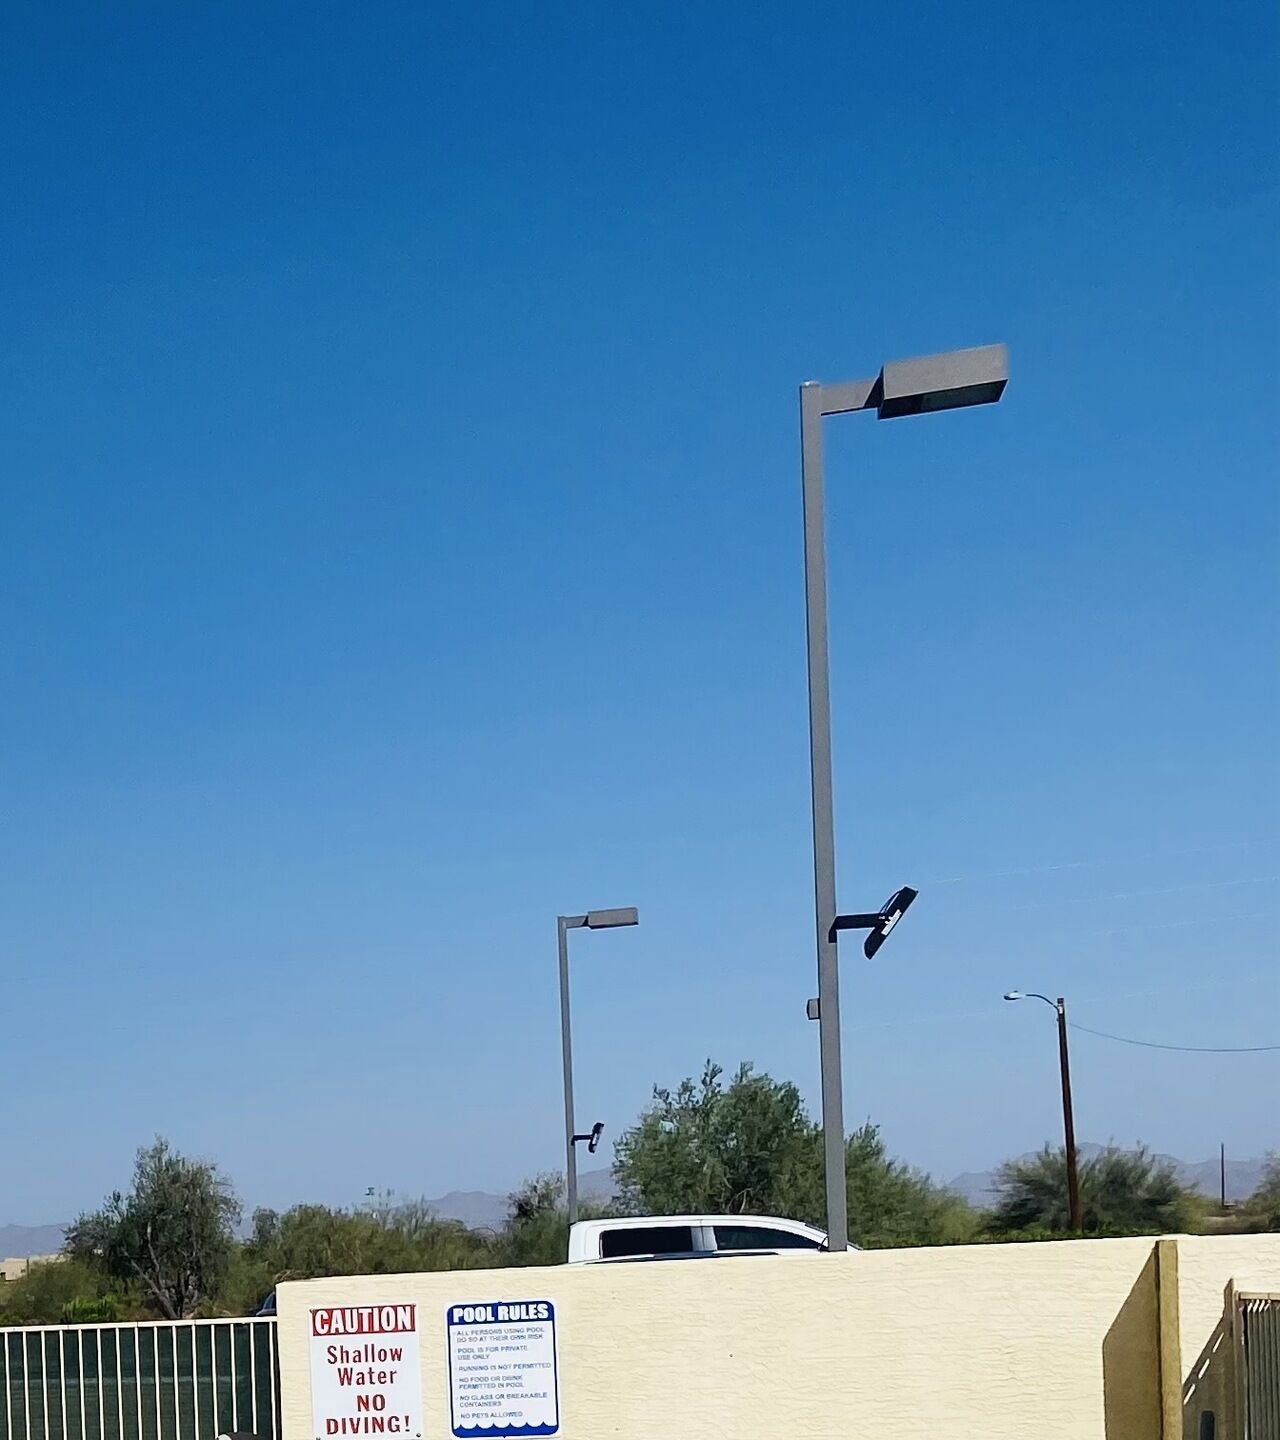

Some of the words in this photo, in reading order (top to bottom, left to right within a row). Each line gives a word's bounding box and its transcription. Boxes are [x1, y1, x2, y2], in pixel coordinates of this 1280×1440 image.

[315, 1306, 412, 1334] CAUTION
[453, 1306, 495, 1323] POOL
[498, 1304, 549, 1320] RULES
[327, 1344, 402, 1364] Shallow
[338, 1367, 397, 1386] Water
[357, 1394, 386, 1412] NO
[326, 1415, 410, 1435] DIVING!
